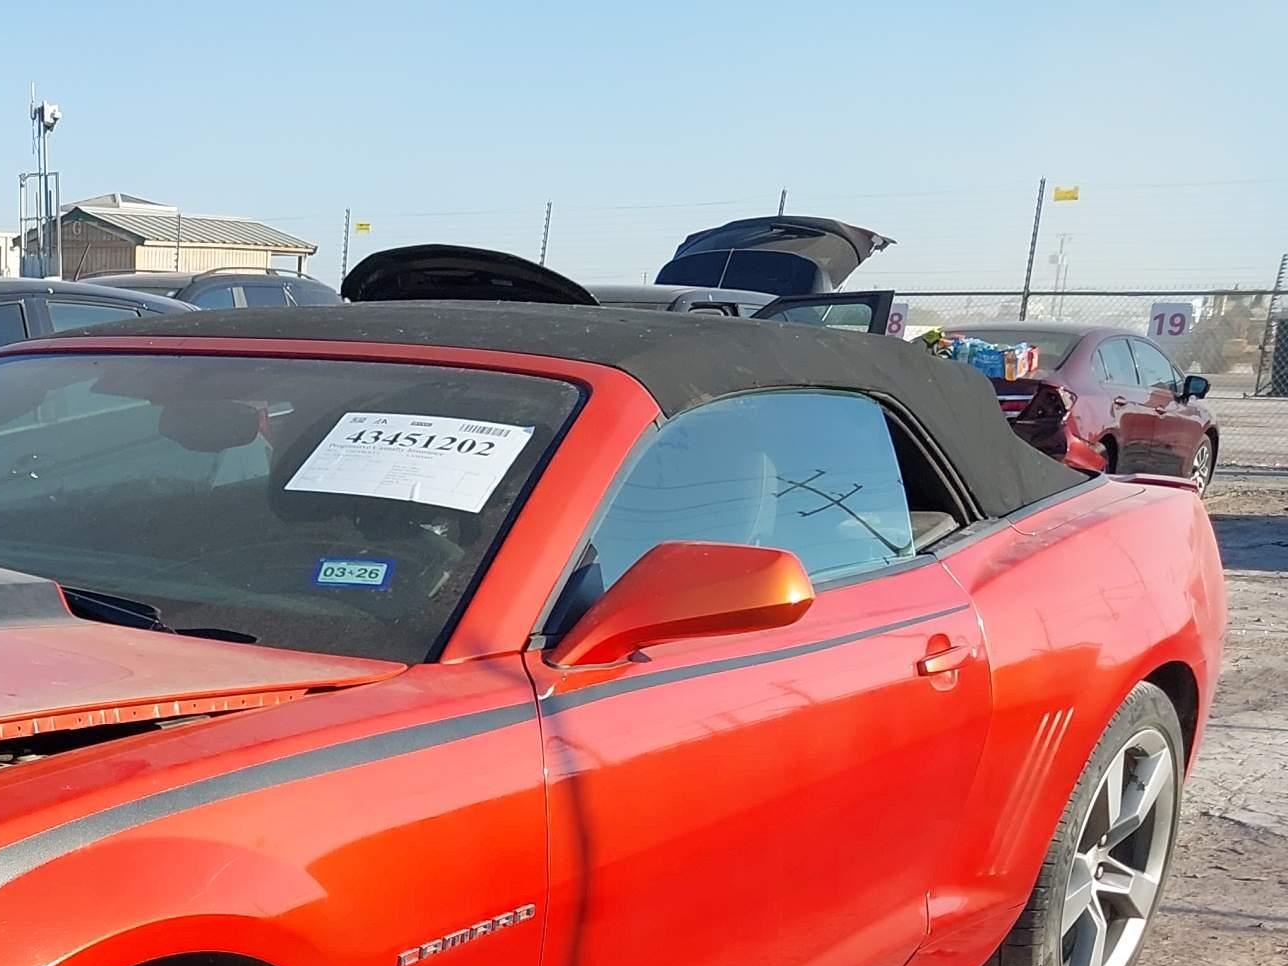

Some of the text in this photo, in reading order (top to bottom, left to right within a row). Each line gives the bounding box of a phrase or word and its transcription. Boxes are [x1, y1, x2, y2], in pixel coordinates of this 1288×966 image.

[887, 311, 903, 334] 8
[1152, 312, 1187, 337] 19
[345, 428, 496, 457] 43451202
